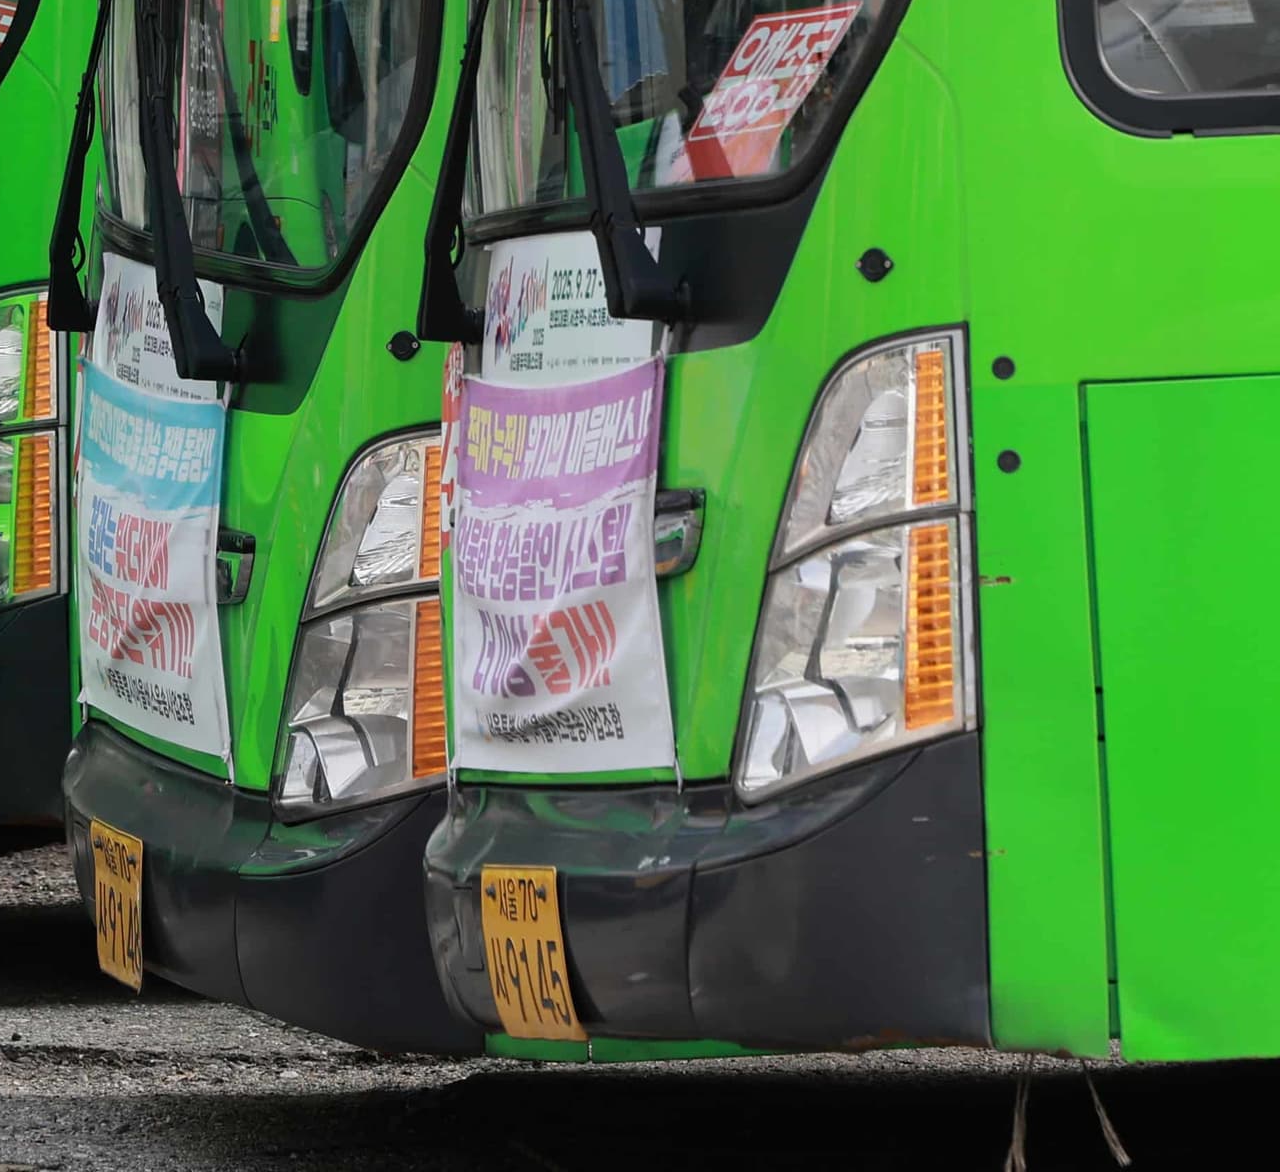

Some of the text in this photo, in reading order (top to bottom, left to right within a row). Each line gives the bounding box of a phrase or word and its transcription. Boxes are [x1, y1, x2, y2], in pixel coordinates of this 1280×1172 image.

[700, 18, 846, 127] 운행종료
[523, 412, 572, 480] 위기의
[565, 388, 653, 477] 마을버스!!
[490, 521, 561, 602] 환승할인
[557, 503, 632, 595] 시스템
[491, 937, 571, 1026] 사9145
